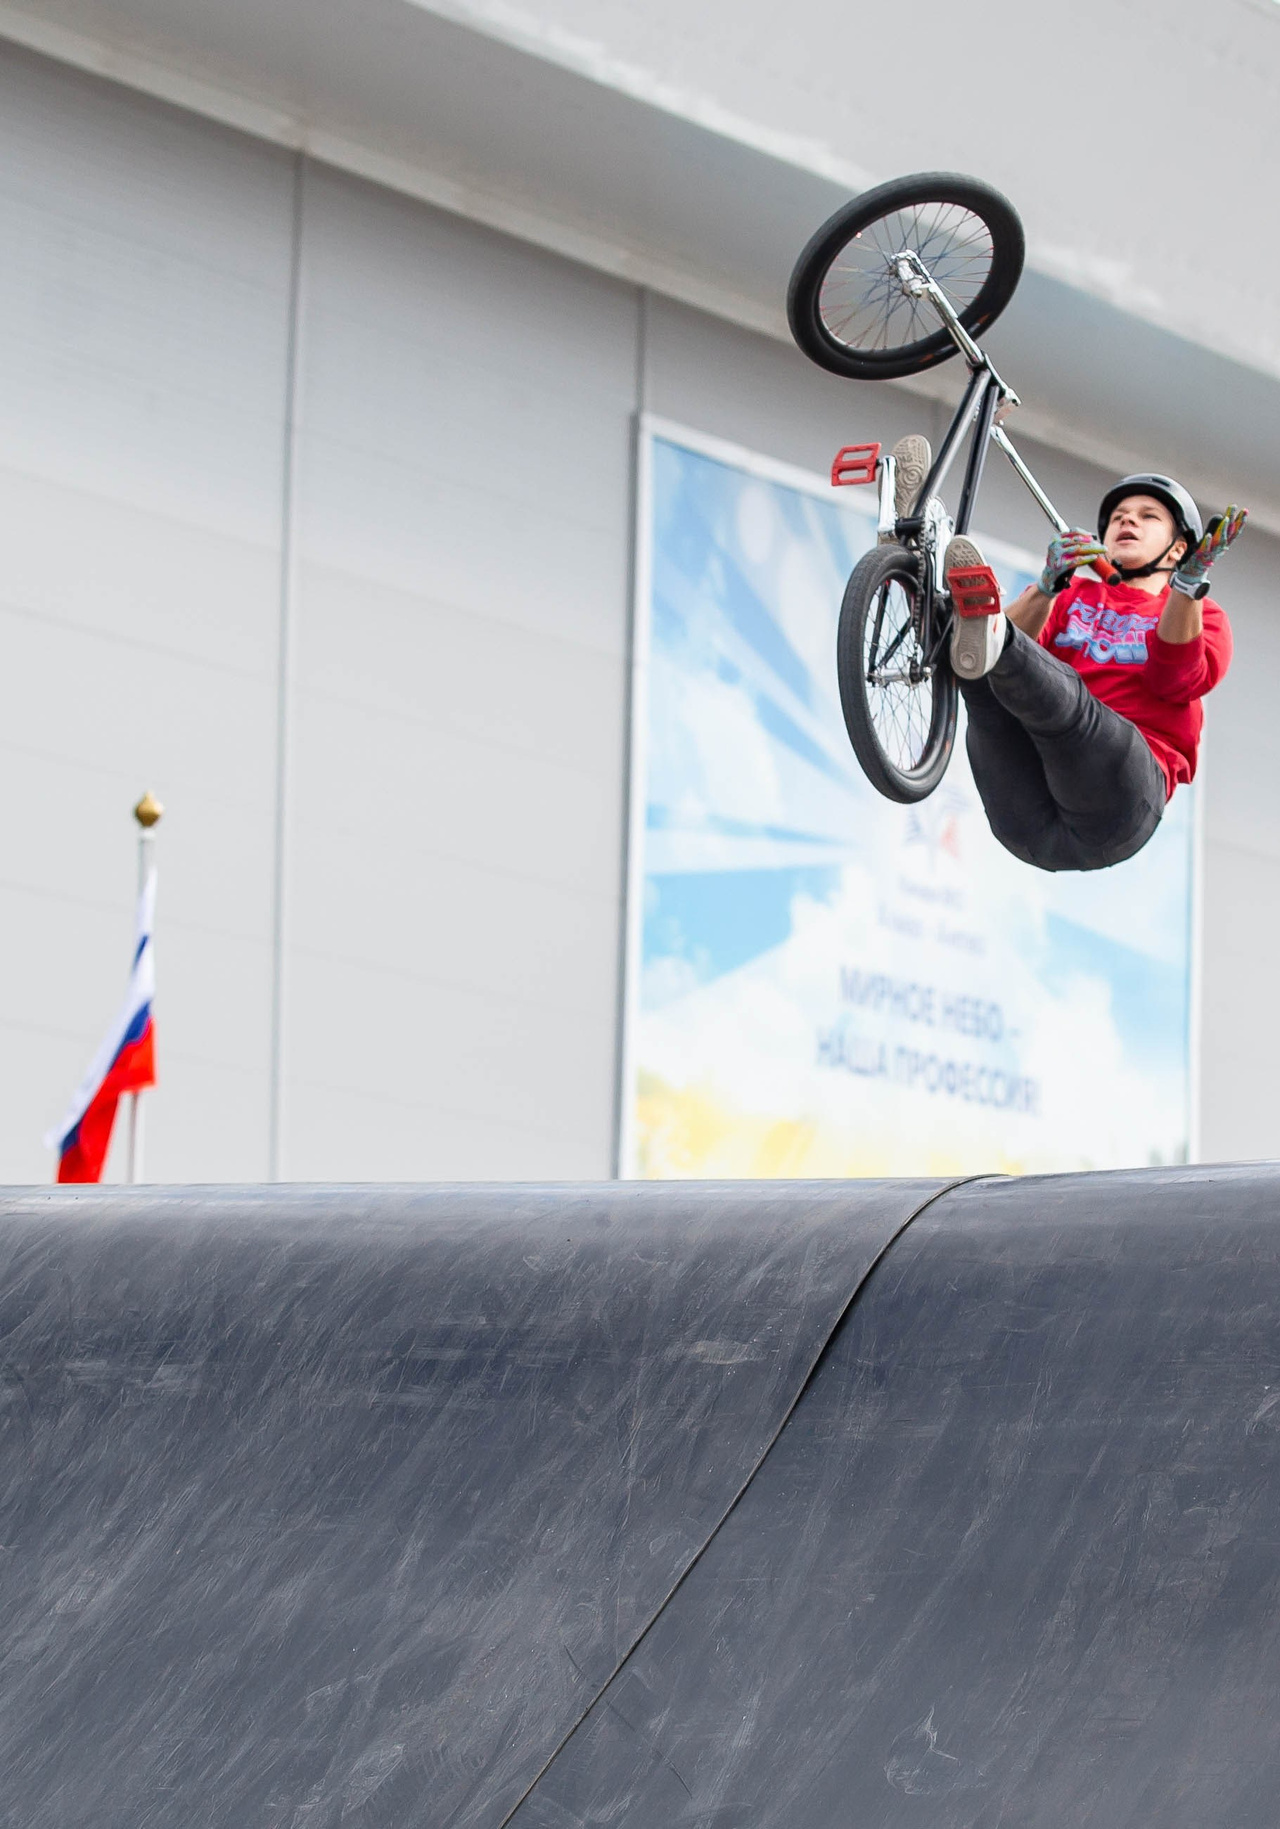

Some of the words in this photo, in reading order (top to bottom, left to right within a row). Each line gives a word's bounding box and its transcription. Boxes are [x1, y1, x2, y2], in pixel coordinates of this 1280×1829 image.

[839, 965, 935, 1028] МИРНОЕ
[942, 992, 1005, 1043] НЕБО
[816, 1026, 887, 1078] НАША
